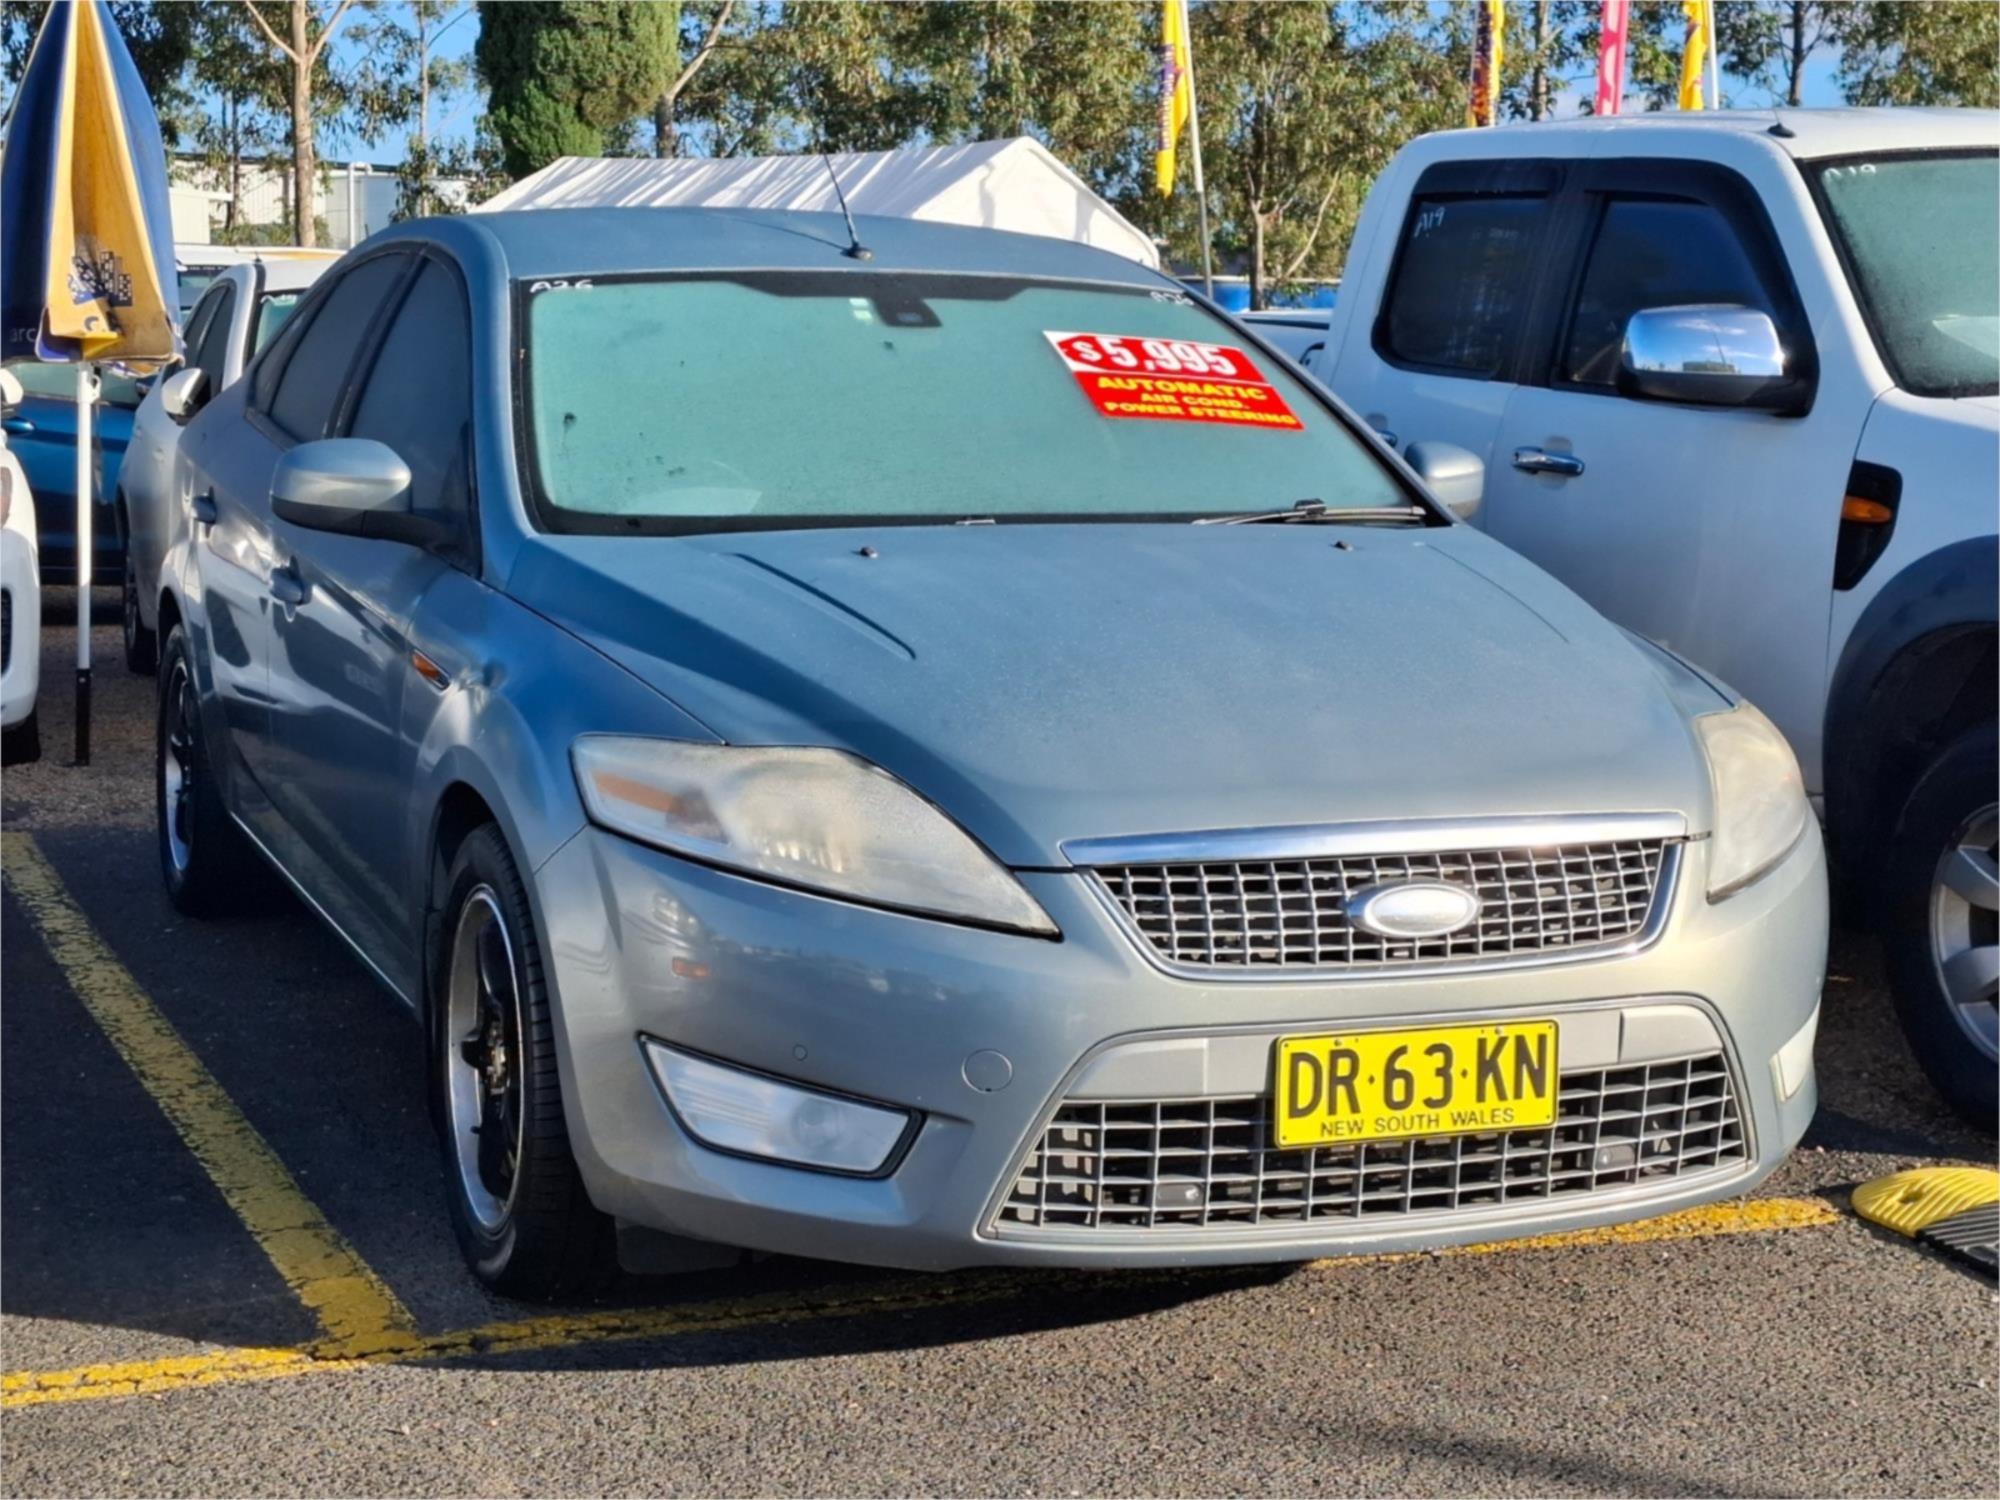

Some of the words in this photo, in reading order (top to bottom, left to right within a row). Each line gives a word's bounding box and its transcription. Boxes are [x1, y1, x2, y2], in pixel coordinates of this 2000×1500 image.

[1072, 336, 1238, 375] $5,995
[1097, 376, 1268, 401] AUTOMATIC
[1140, 392, 1178, 405] AIR
[1103, 401, 1187, 416] POWER
[1189, 406, 1298, 425] STEERING
[1319, 1118, 1365, 1138] NEW
[1373, 1113, 1441, 1134] SOUTH
[1450, 1106, 1516, 1127] WALES
